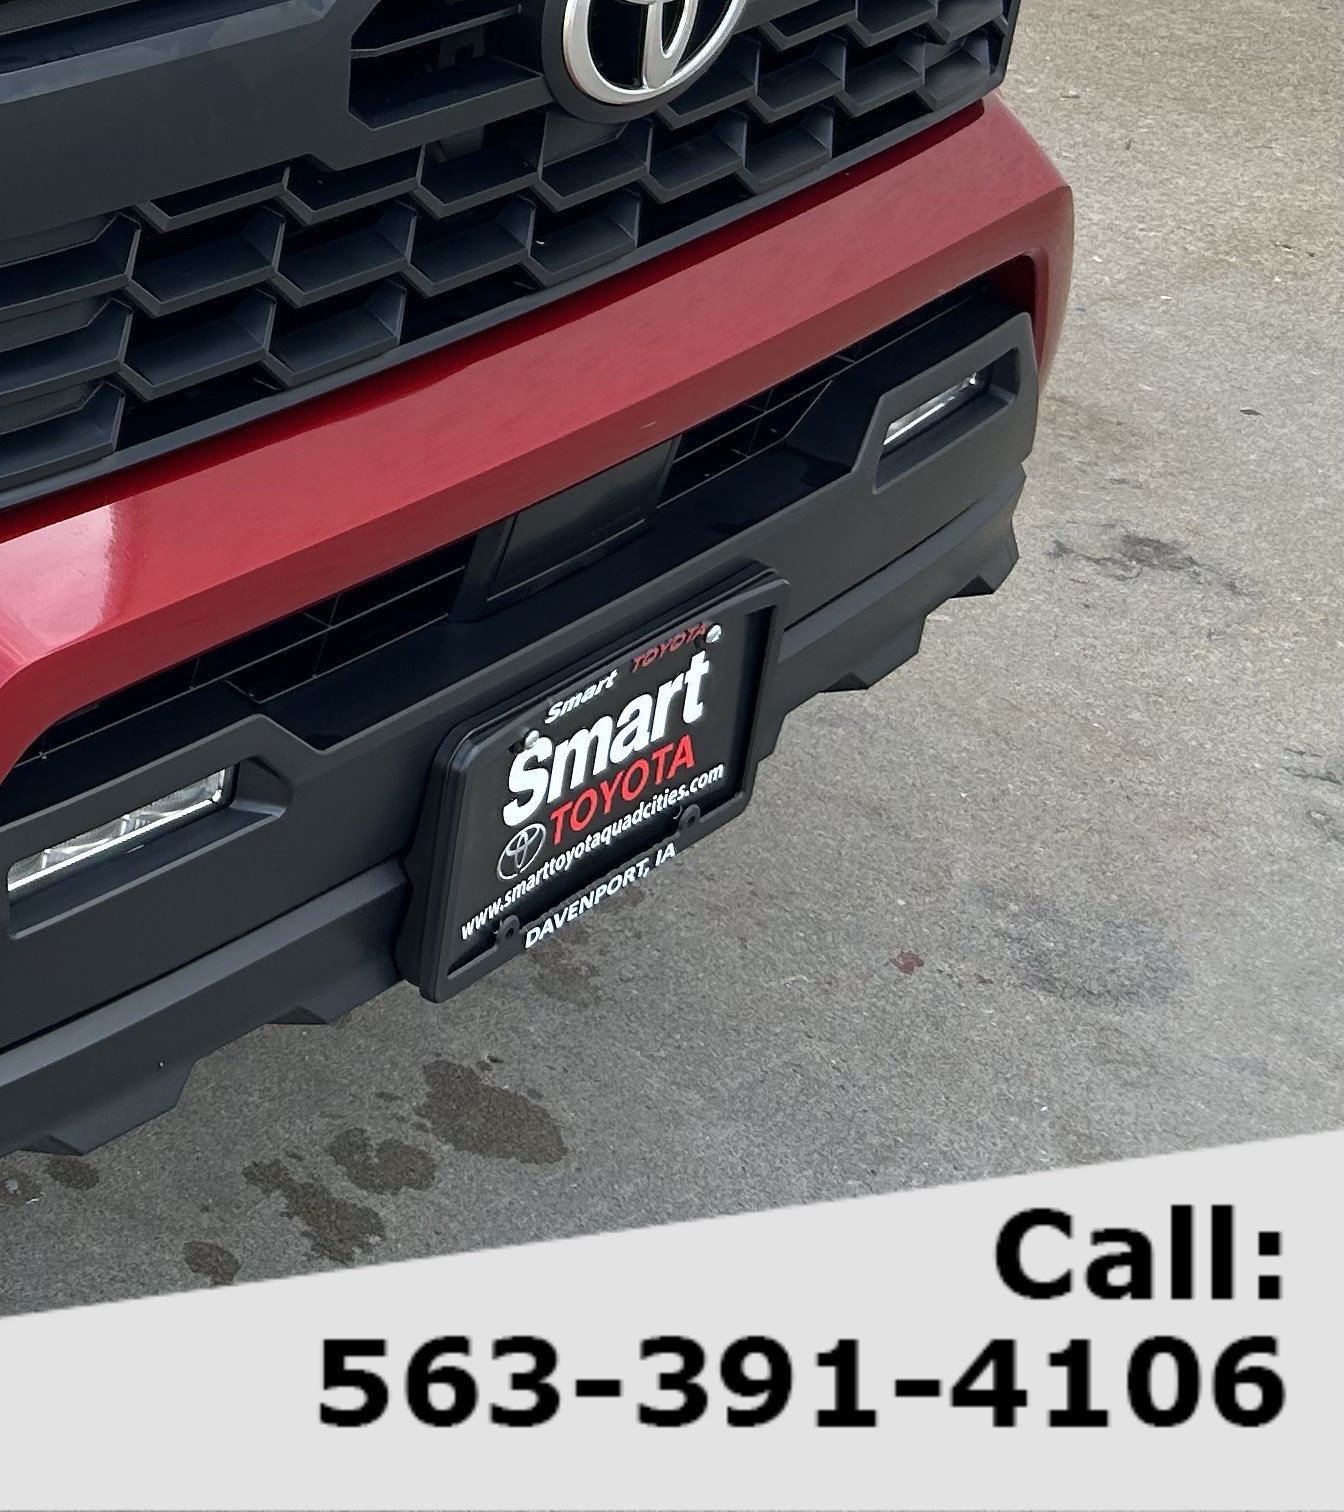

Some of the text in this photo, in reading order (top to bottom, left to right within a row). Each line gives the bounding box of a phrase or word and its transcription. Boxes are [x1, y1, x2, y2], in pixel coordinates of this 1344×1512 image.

[544, 621, 708, 725] Smart TOYOTA
[502, 650, 710, 827] Smart
[550, 734, 696, 846] TOYOTA
[461, 763, 726, 940] www.smarttoyotaquadcities.com
[524, 841, 678, 949] DAVENPORT, IA
